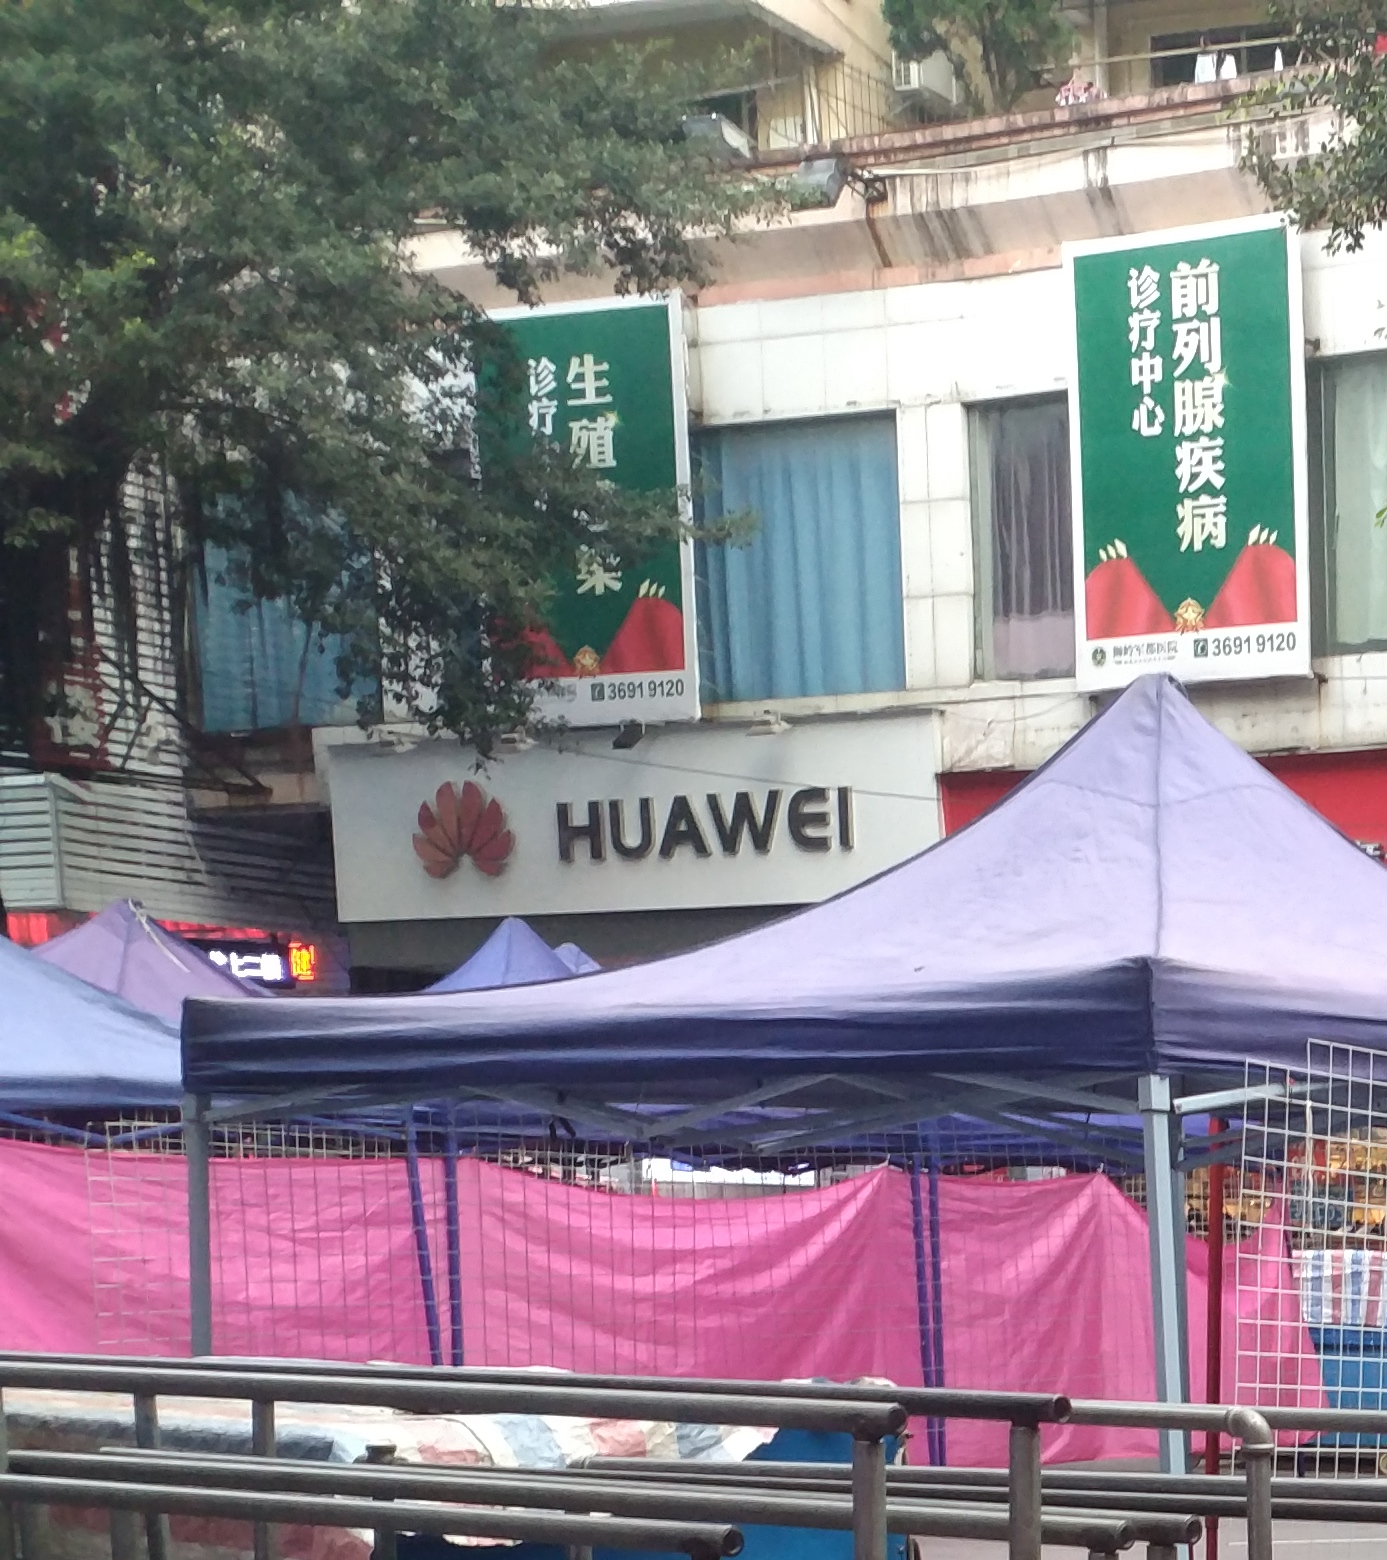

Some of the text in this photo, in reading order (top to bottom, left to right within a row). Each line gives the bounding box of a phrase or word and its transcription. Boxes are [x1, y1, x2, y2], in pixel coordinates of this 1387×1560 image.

[1127, 264, 1166, 438] 诊疗中心
[1170, 257, 1228, 554] 前列腺疾病
[566, 353, 622, 596] 生殖染
[556, 786, 856, 864] HUAWEI
